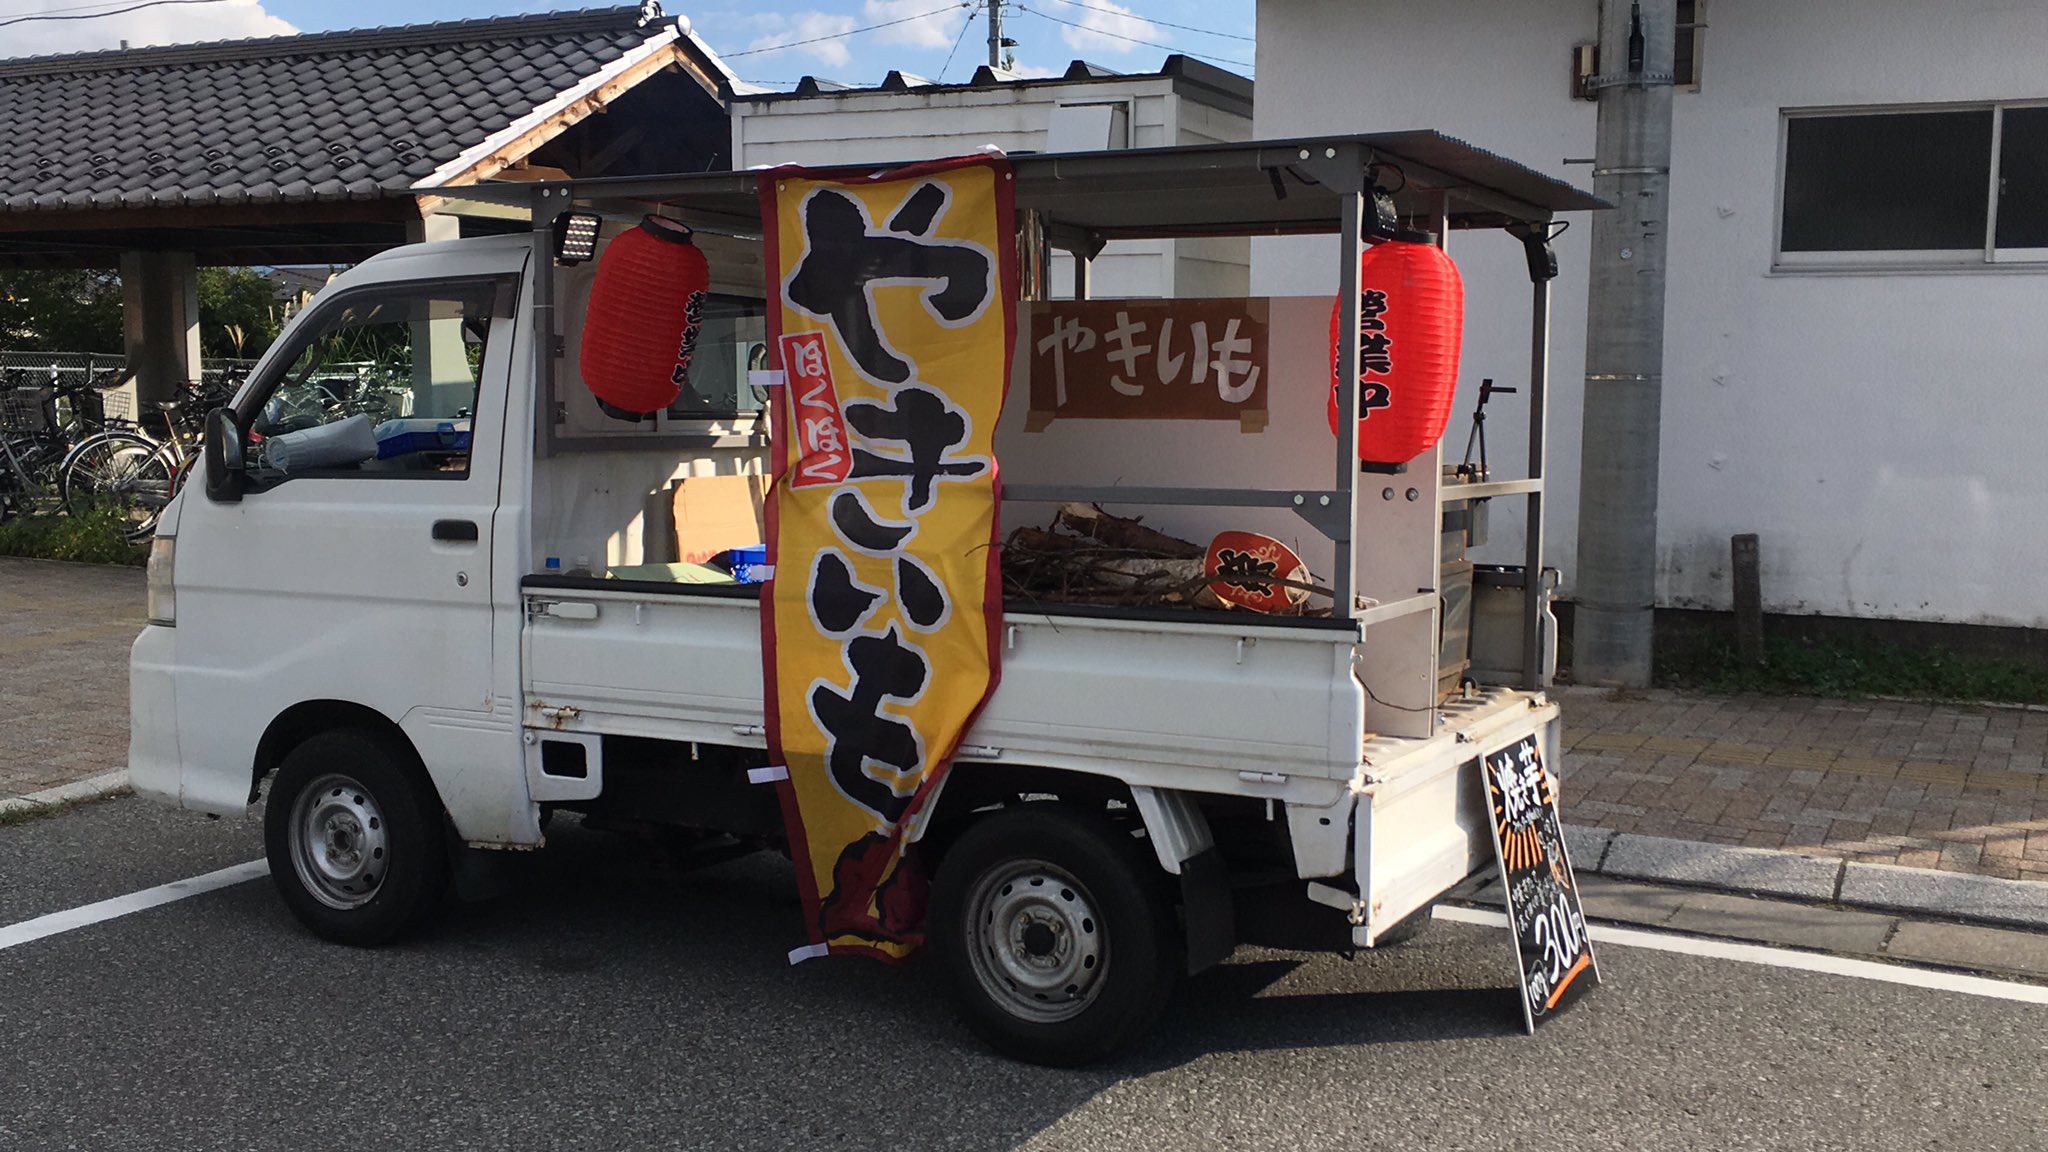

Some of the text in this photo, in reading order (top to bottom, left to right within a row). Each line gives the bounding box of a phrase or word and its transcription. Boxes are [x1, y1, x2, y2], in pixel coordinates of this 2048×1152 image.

[792, 340, 844, 480] ほくほく
[1037, 312, 1261, 407] やきいも
[781, 179, 995, 824] やきいも
